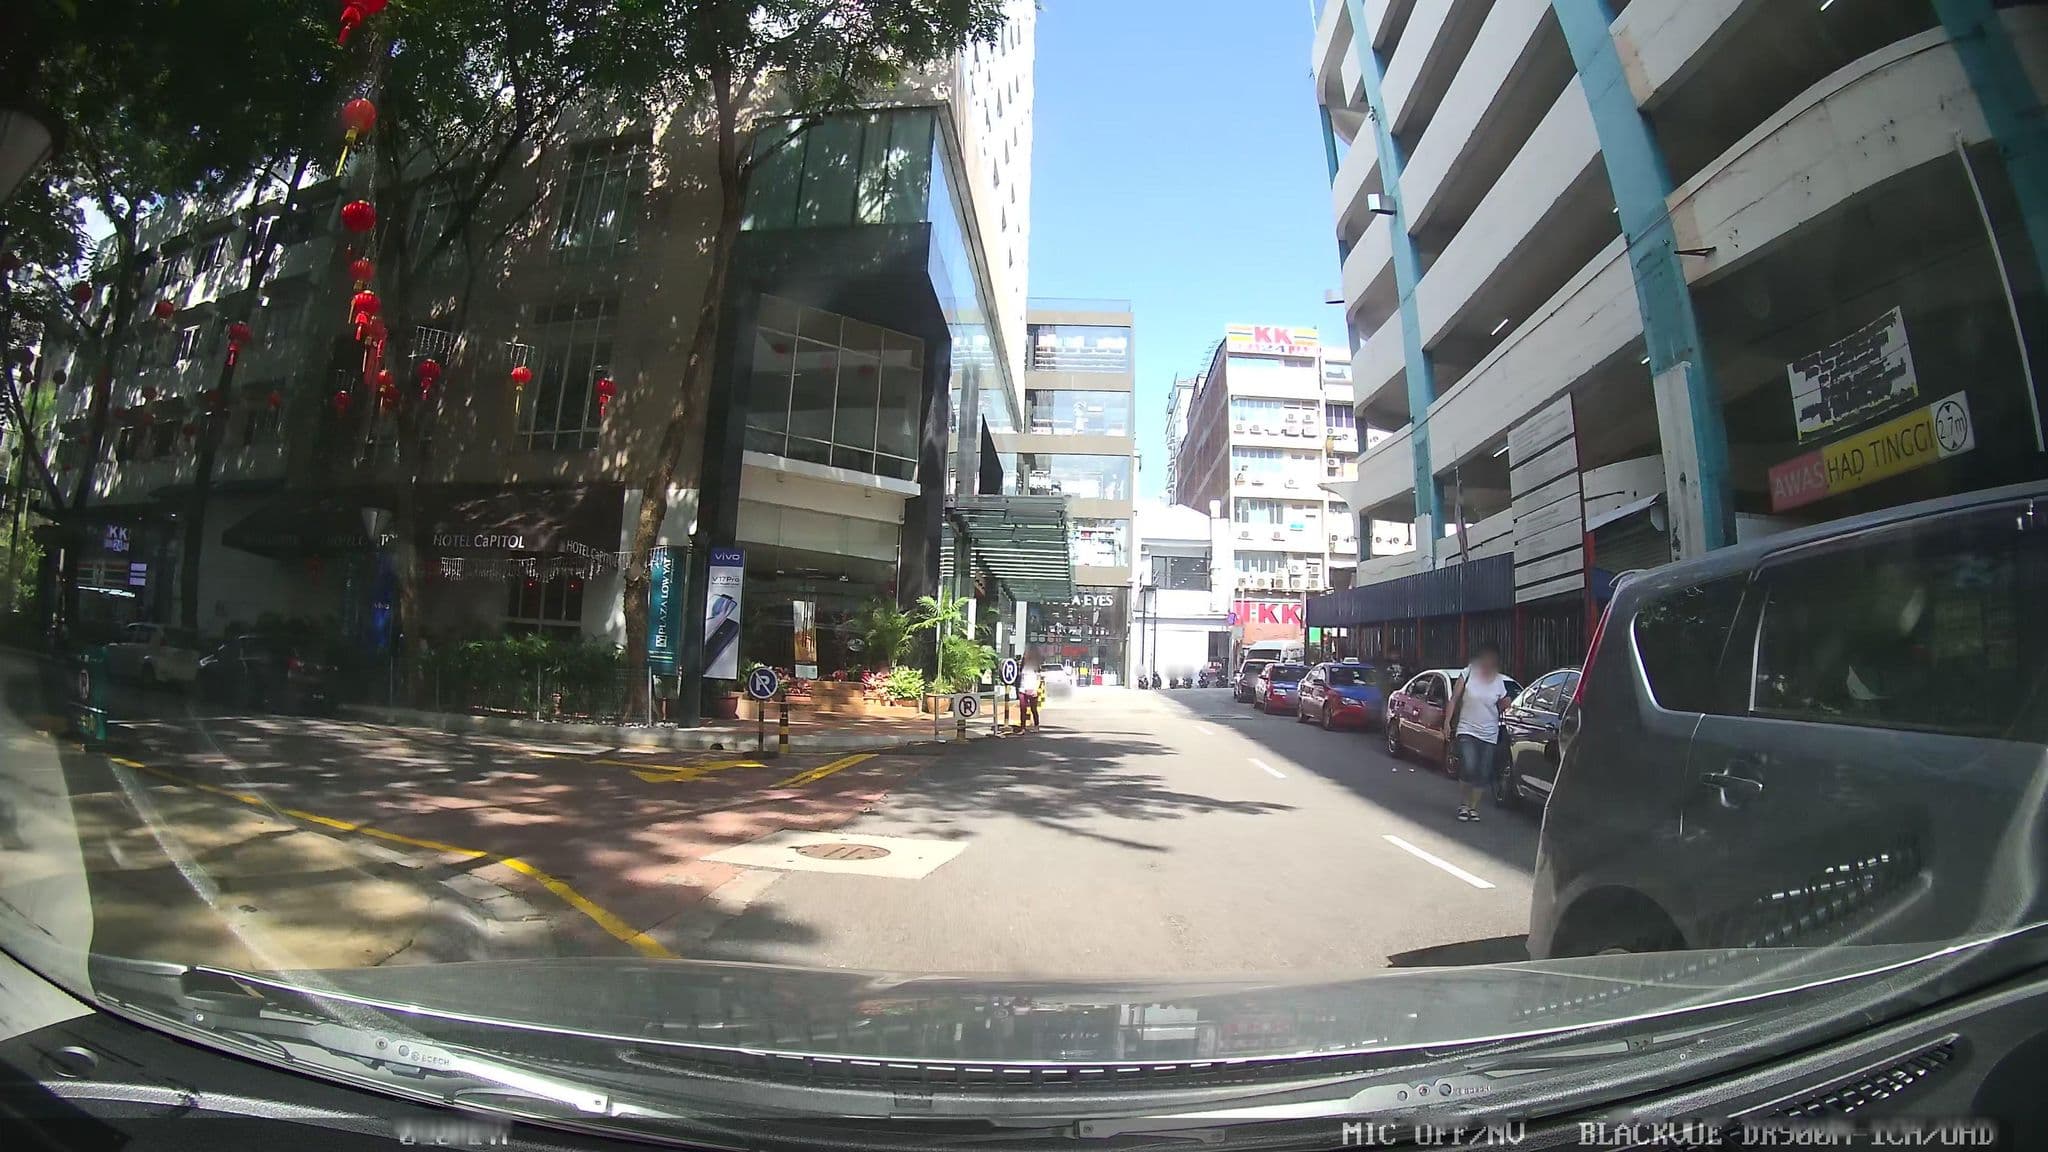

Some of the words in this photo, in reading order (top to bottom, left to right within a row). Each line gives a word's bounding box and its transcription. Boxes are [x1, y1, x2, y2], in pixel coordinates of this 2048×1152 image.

[1254, 326, 1292, 344] KK
[1773, 464, 1825, 499] AWAS
[1826, 448, 1865, 484] HAD
[1869, 421, 1934, 467] TINGGI
[109, 525, 128, 540] KK
[433, 534, 470, 548] HOTEL
[566, 539, 590, 558] HOTEL
[714, 552, 741, 561] vivo
[658, 600, 668, 635] PLAZA
[1258, 603, 1303, 624] KK
